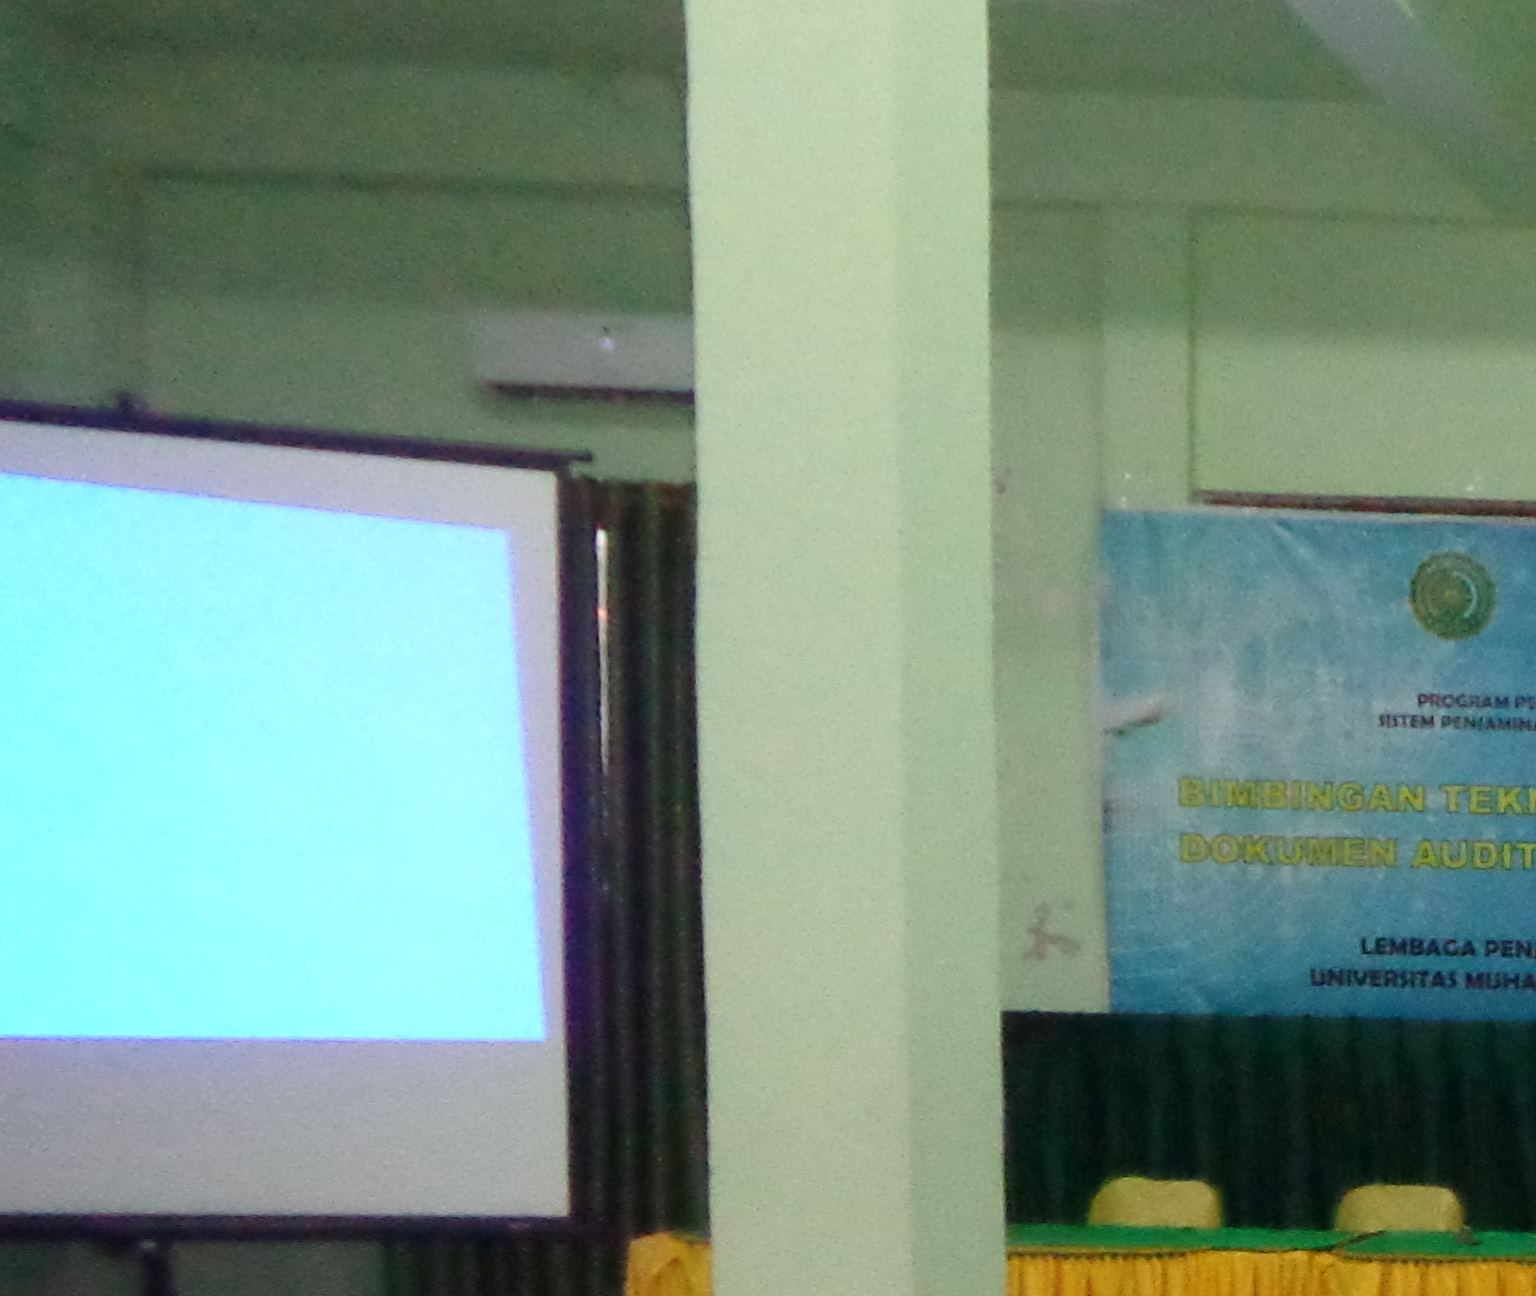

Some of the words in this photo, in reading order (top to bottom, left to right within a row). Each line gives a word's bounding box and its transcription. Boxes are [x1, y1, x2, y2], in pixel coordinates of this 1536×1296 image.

[1417, 693, 1509, 708] PROGRAM
[1178, 776, 1426, 813] BIMBINGAN
[1178, 832, 1397, 867] DOKUMEN
[1360, 937, 1476, 956] LEMBAGA
[1310, 968, 1457, 988] UNIVERSITAS
